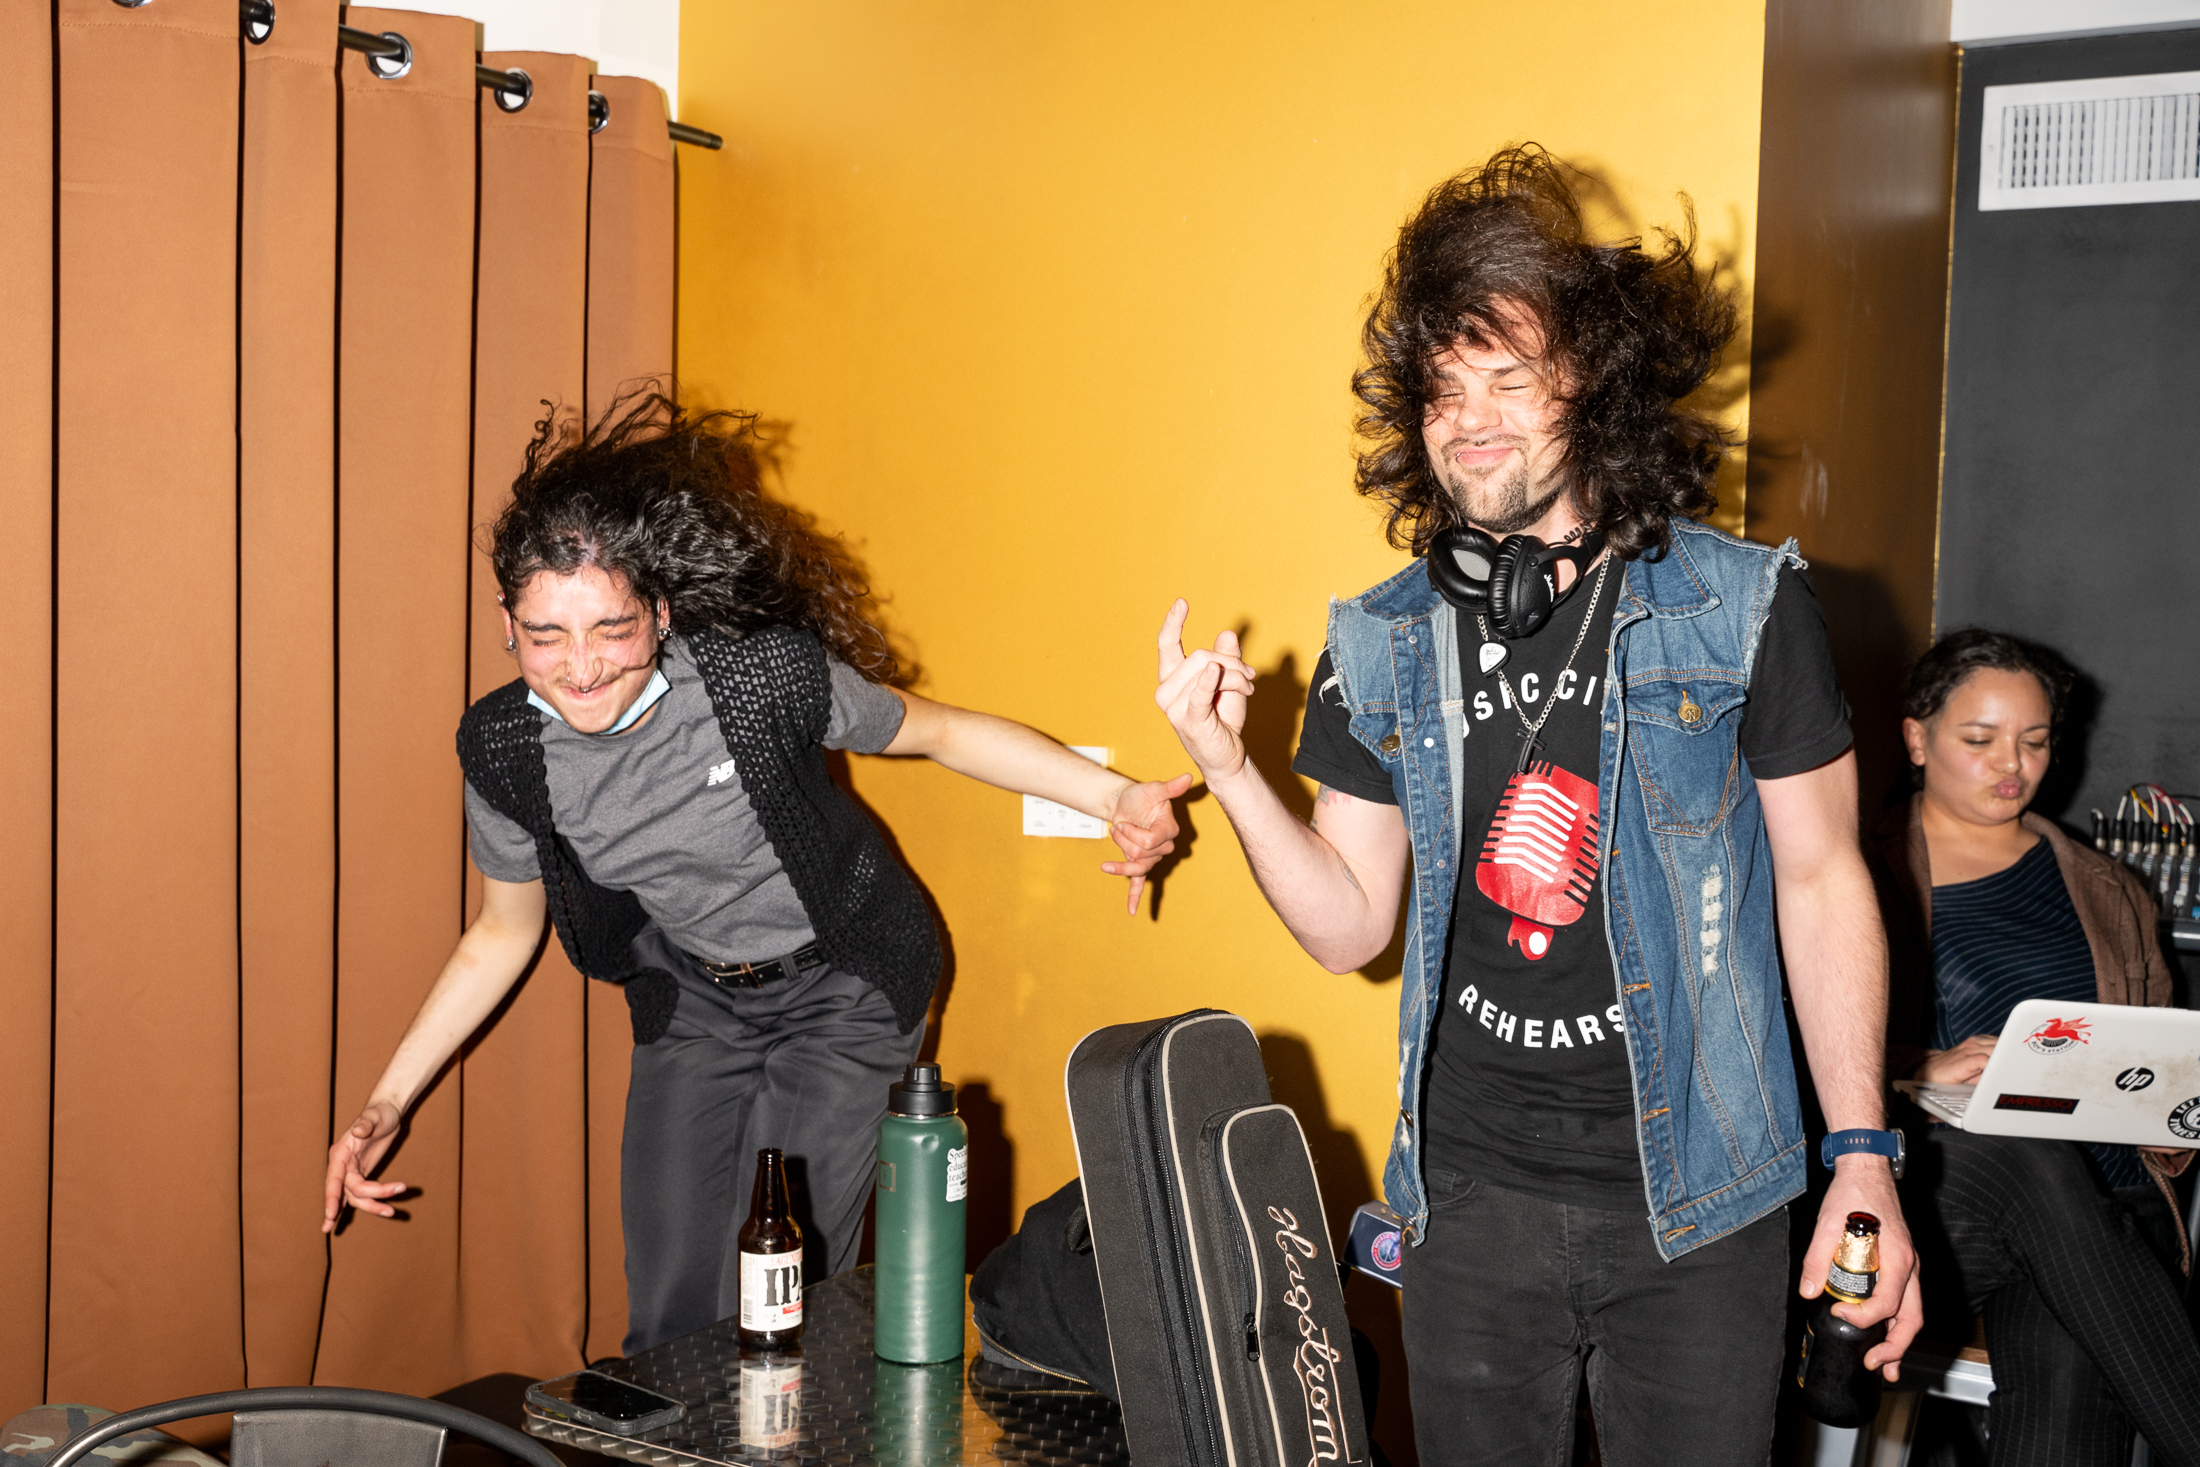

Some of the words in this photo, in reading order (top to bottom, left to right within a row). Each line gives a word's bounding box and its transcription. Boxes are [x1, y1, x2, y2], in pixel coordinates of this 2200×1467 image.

[2117, 1068, 2153, 1092] hp
[1999, 1095, 2073, 1110] EMPRESSO
[2176, 1099, 2194, 1114] LET
[2170, 1118, 2197, 1138] TIMES
[764, 1265, 801, 1306] IP
